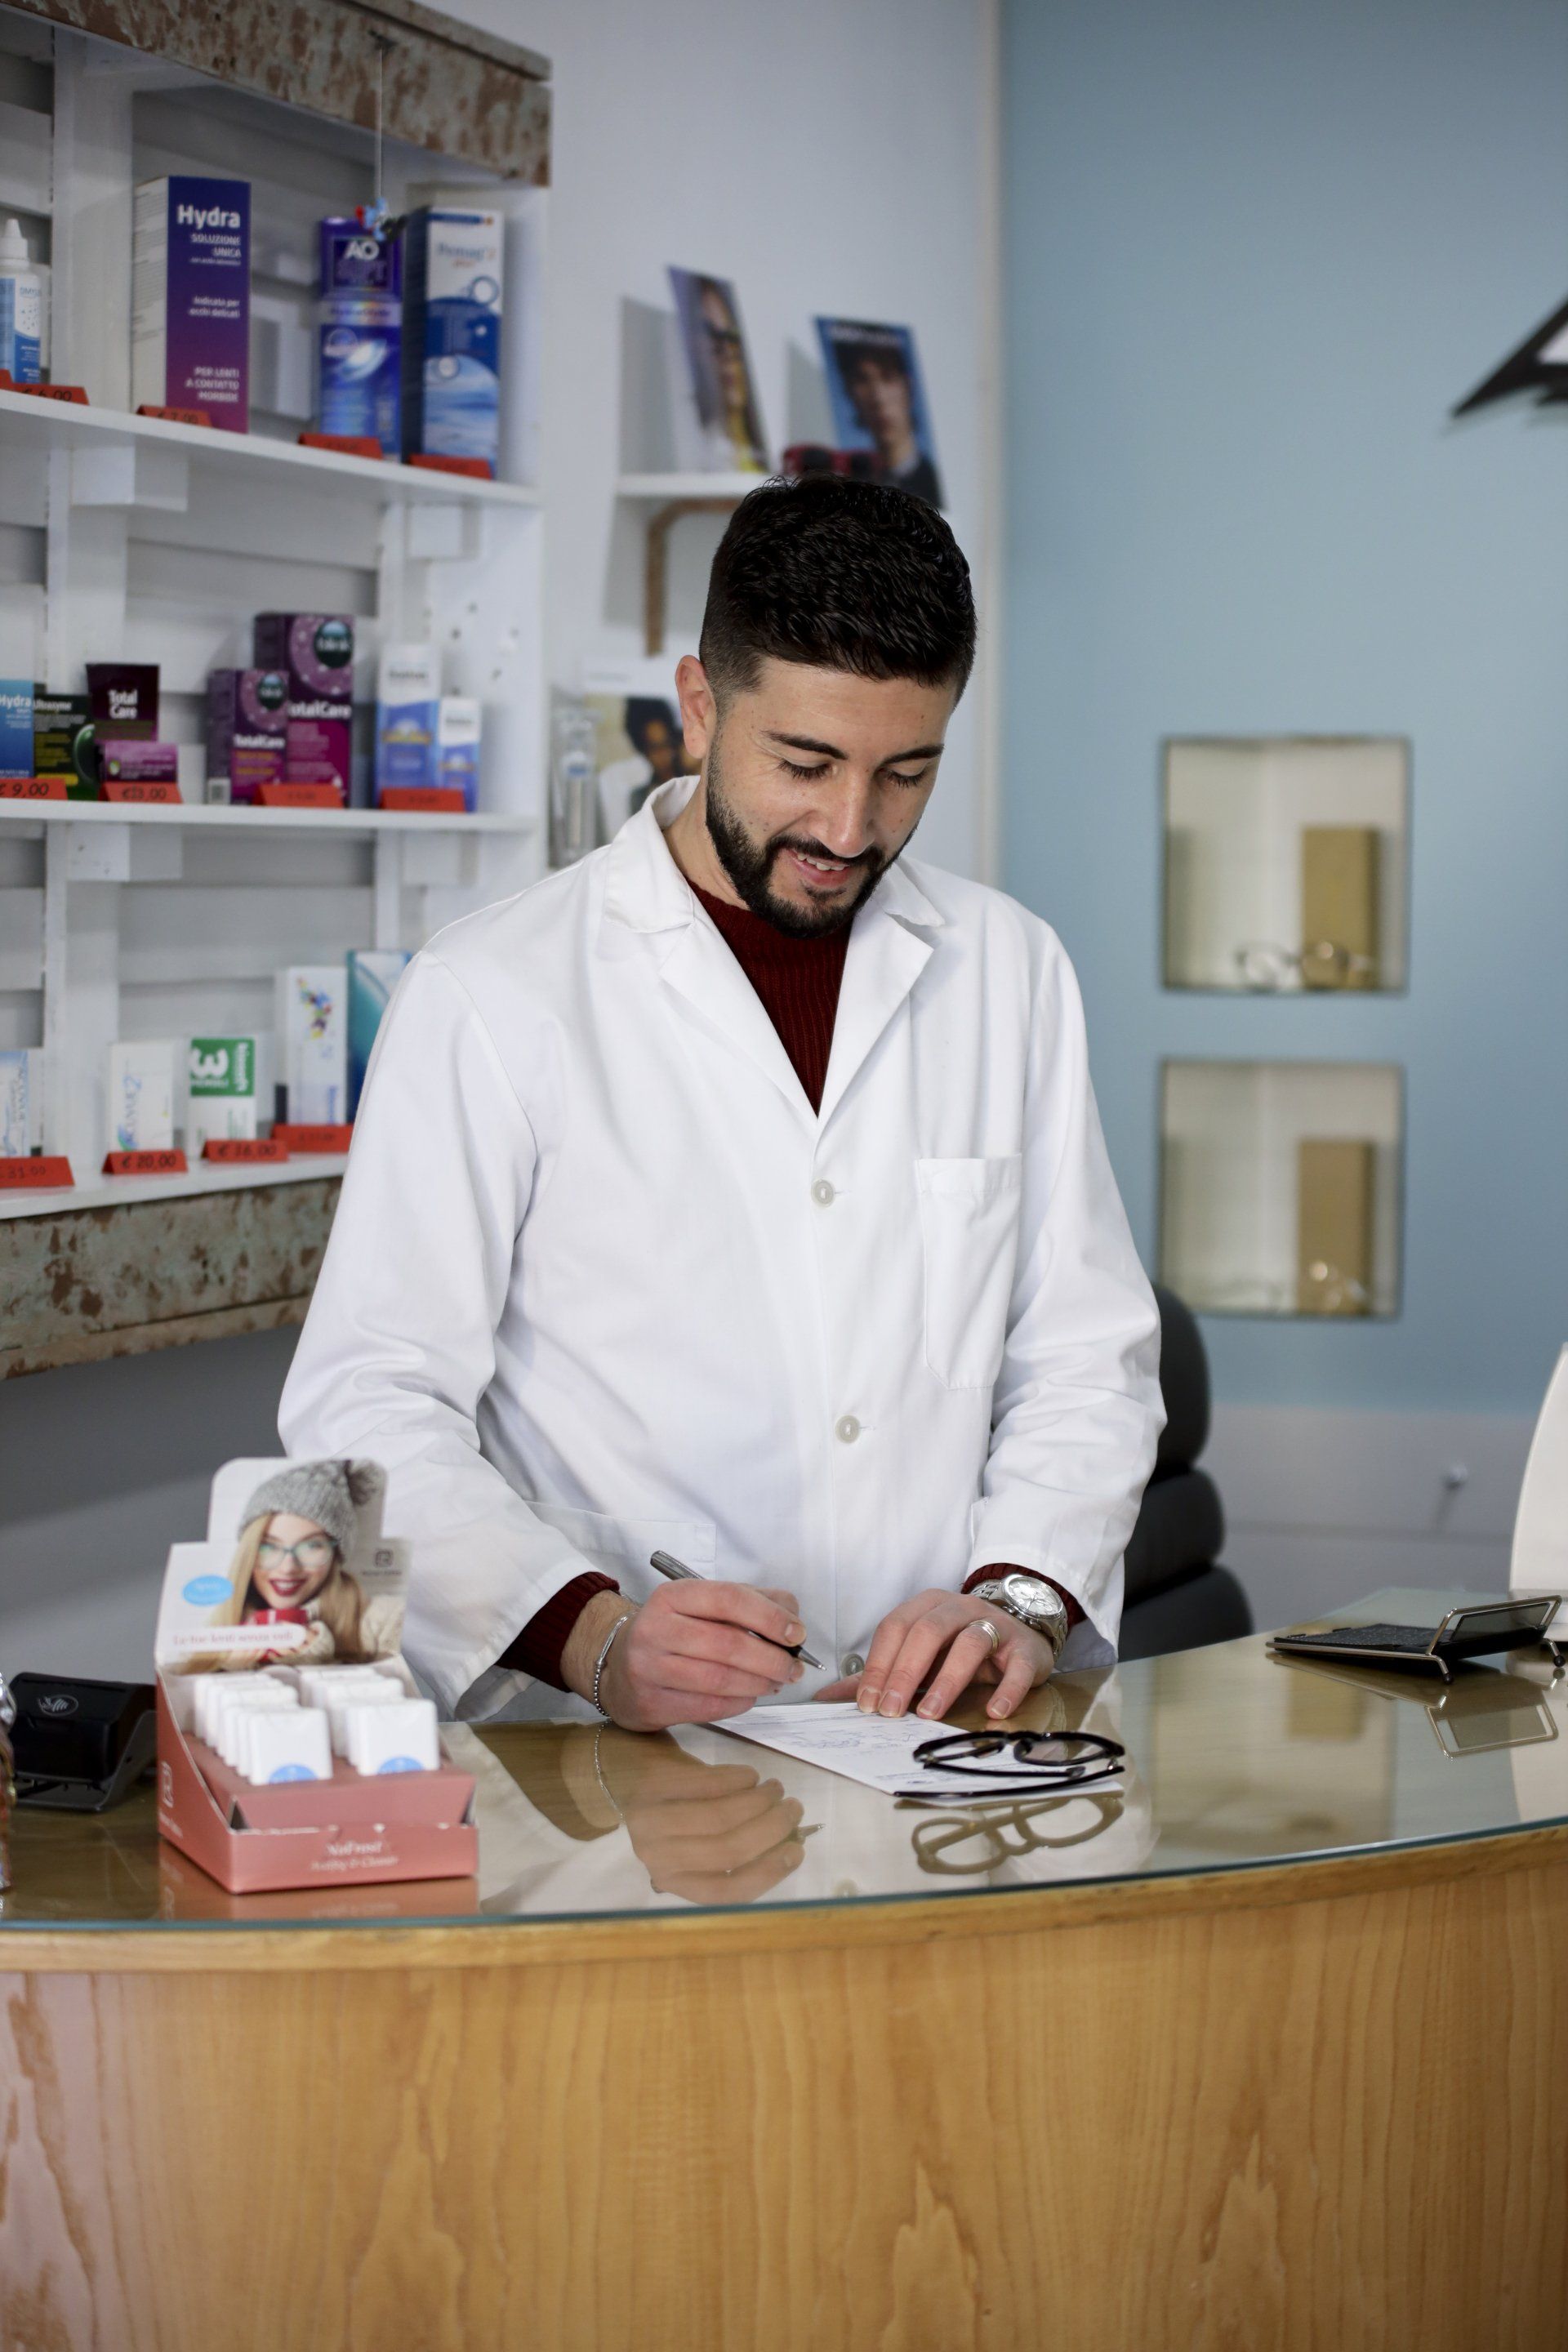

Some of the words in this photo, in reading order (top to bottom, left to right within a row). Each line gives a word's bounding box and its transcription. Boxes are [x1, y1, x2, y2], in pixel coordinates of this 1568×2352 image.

[177, 204, 241, 229] Hydra
[191, 233, 241, 245] SOLUZIONE
[213, 247, 242, 259] UNICA
[194, 367, 213, 376] PER
[185, 377, 194, 388] A
[109, 689, 137, 705] Total
[109, 704, 137, 719] Care
[234, 734, 285, 748] TotalCare
[13, 782, 48, 797] 9,00
